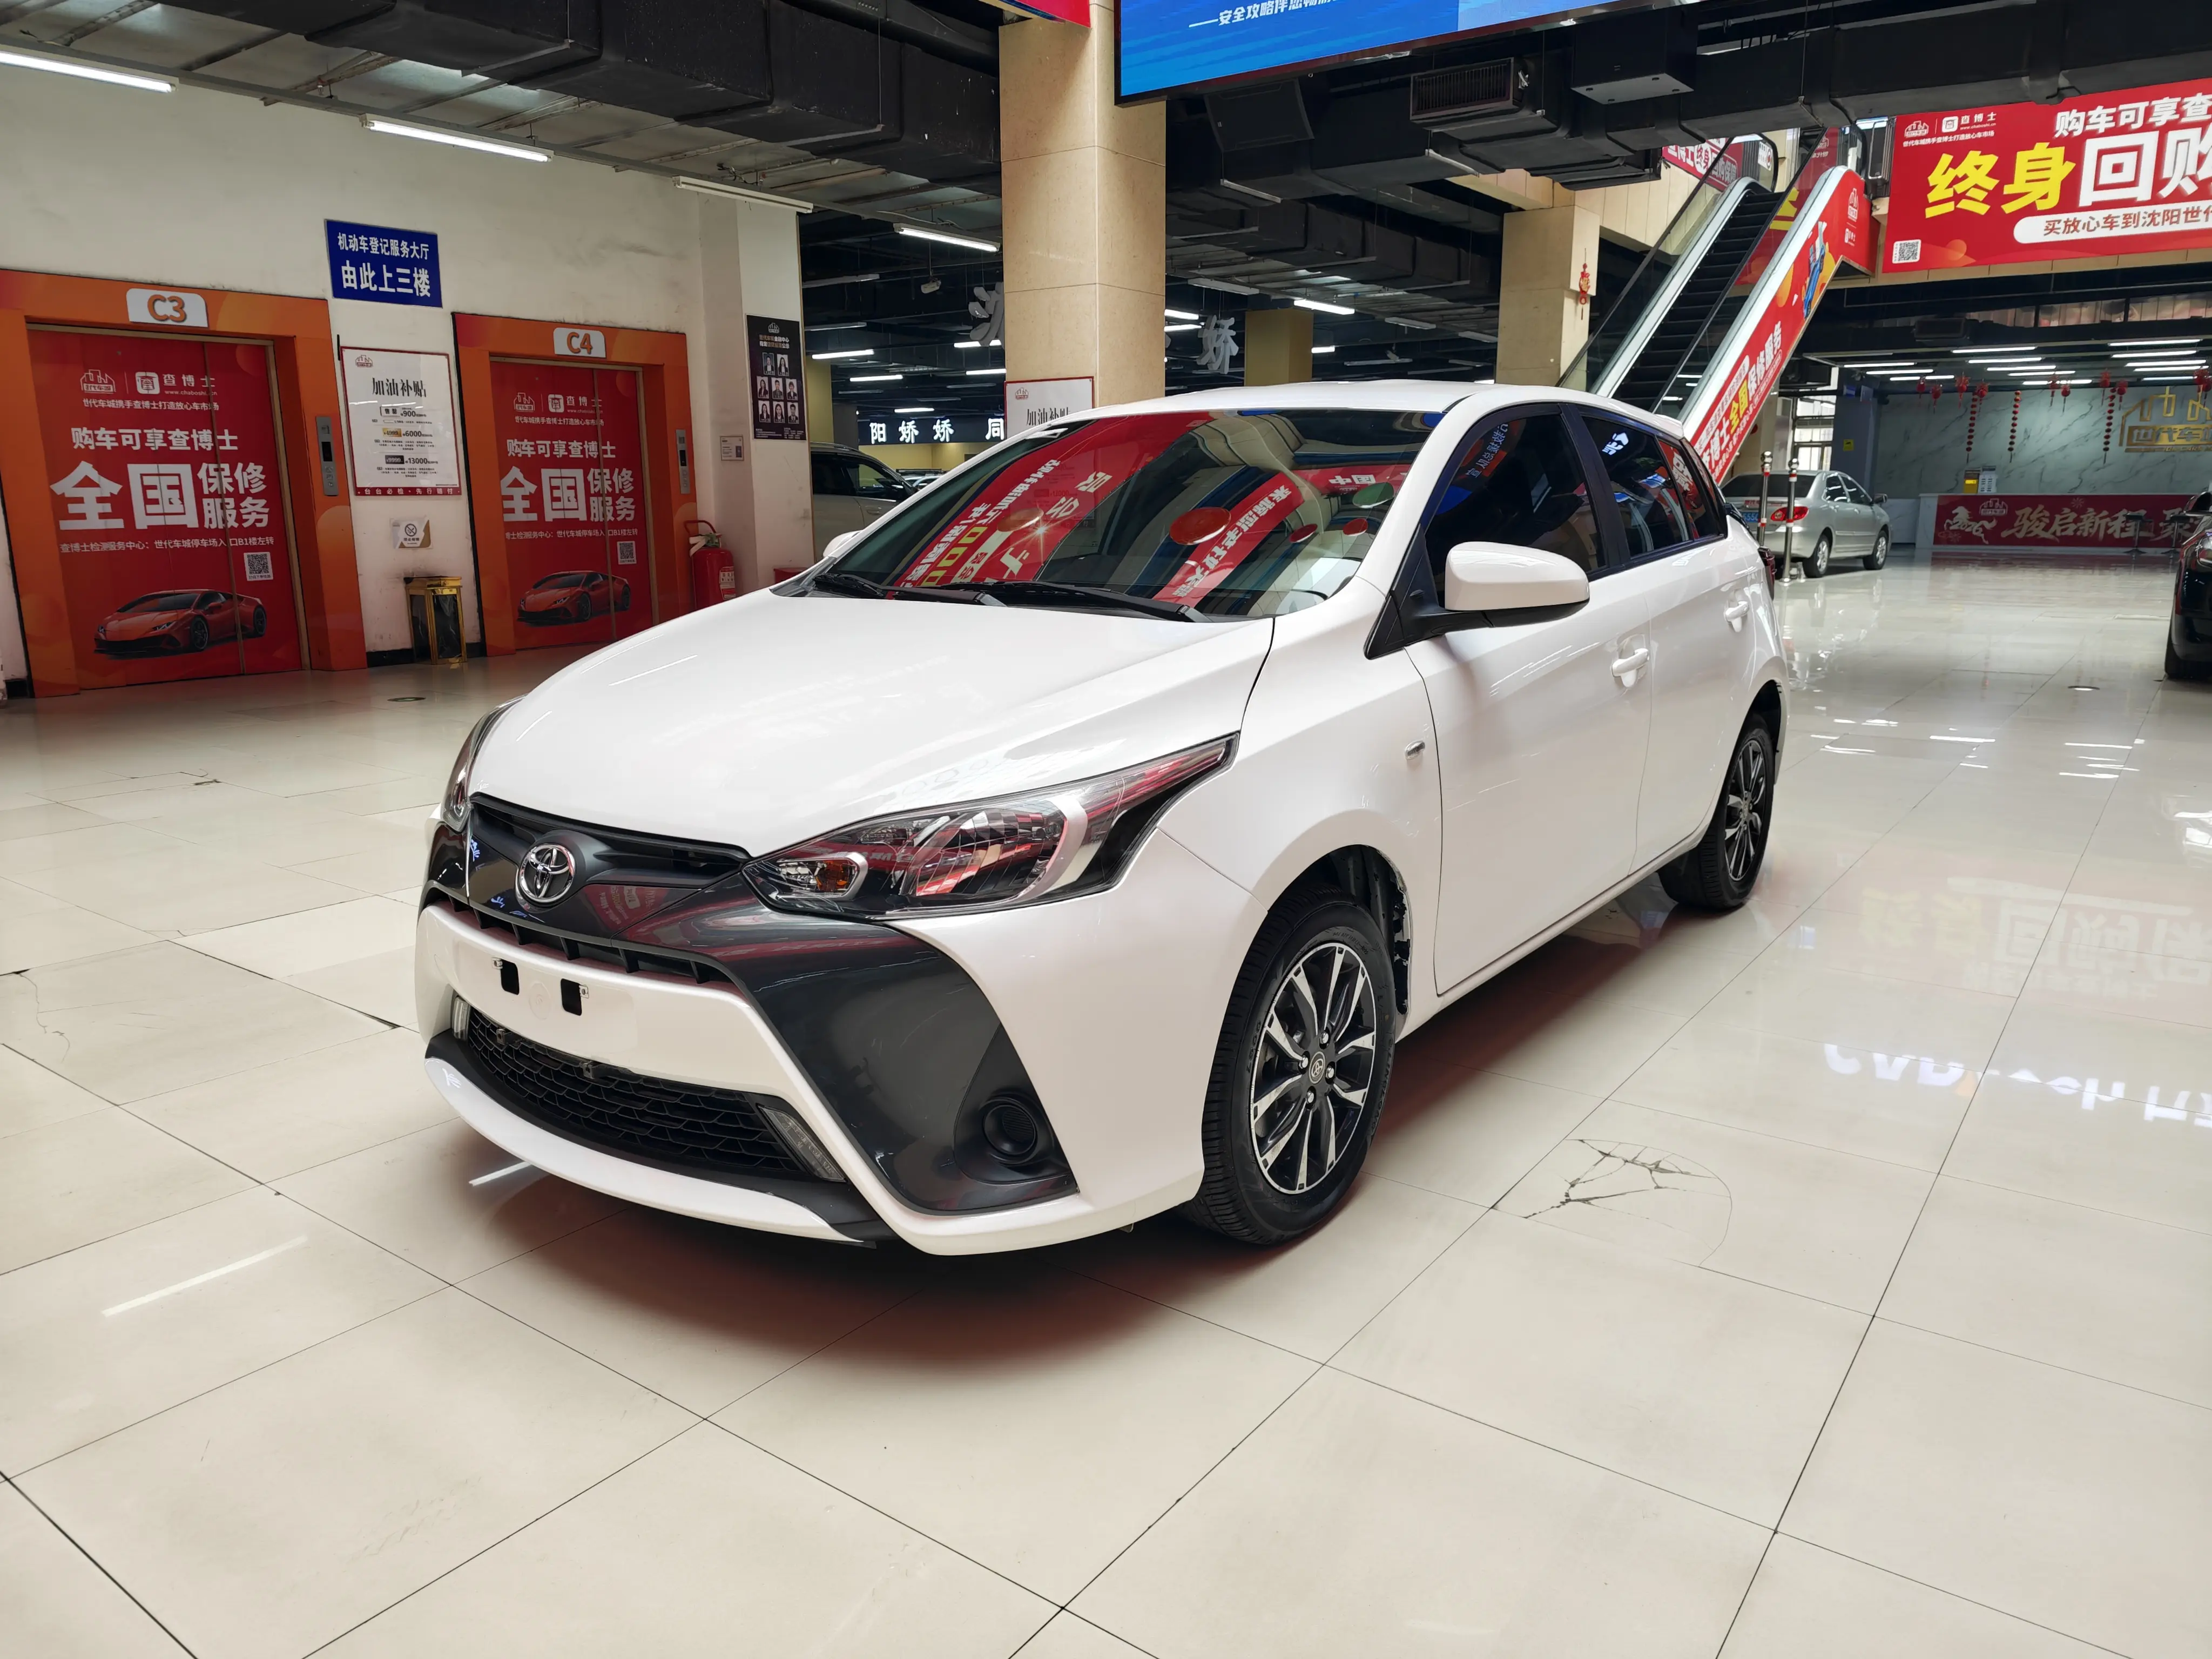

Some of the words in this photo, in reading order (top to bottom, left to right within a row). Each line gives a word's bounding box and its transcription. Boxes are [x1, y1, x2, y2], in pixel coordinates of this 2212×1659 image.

[1960, 111, 1997, 125] 查博士
[338, 232, 429, 260] 机动车登记服务大厅
[341, 260, 430, 297] 由此上三楼
[146, 294, 186, 323] C3
[566, 332, 593, 355] C4
[372, 377, 427, 397] 加油补贴
[71, 427, 239, 451] 购车可享查博士
[507, 438, 616, 458] 购车可享查博士
